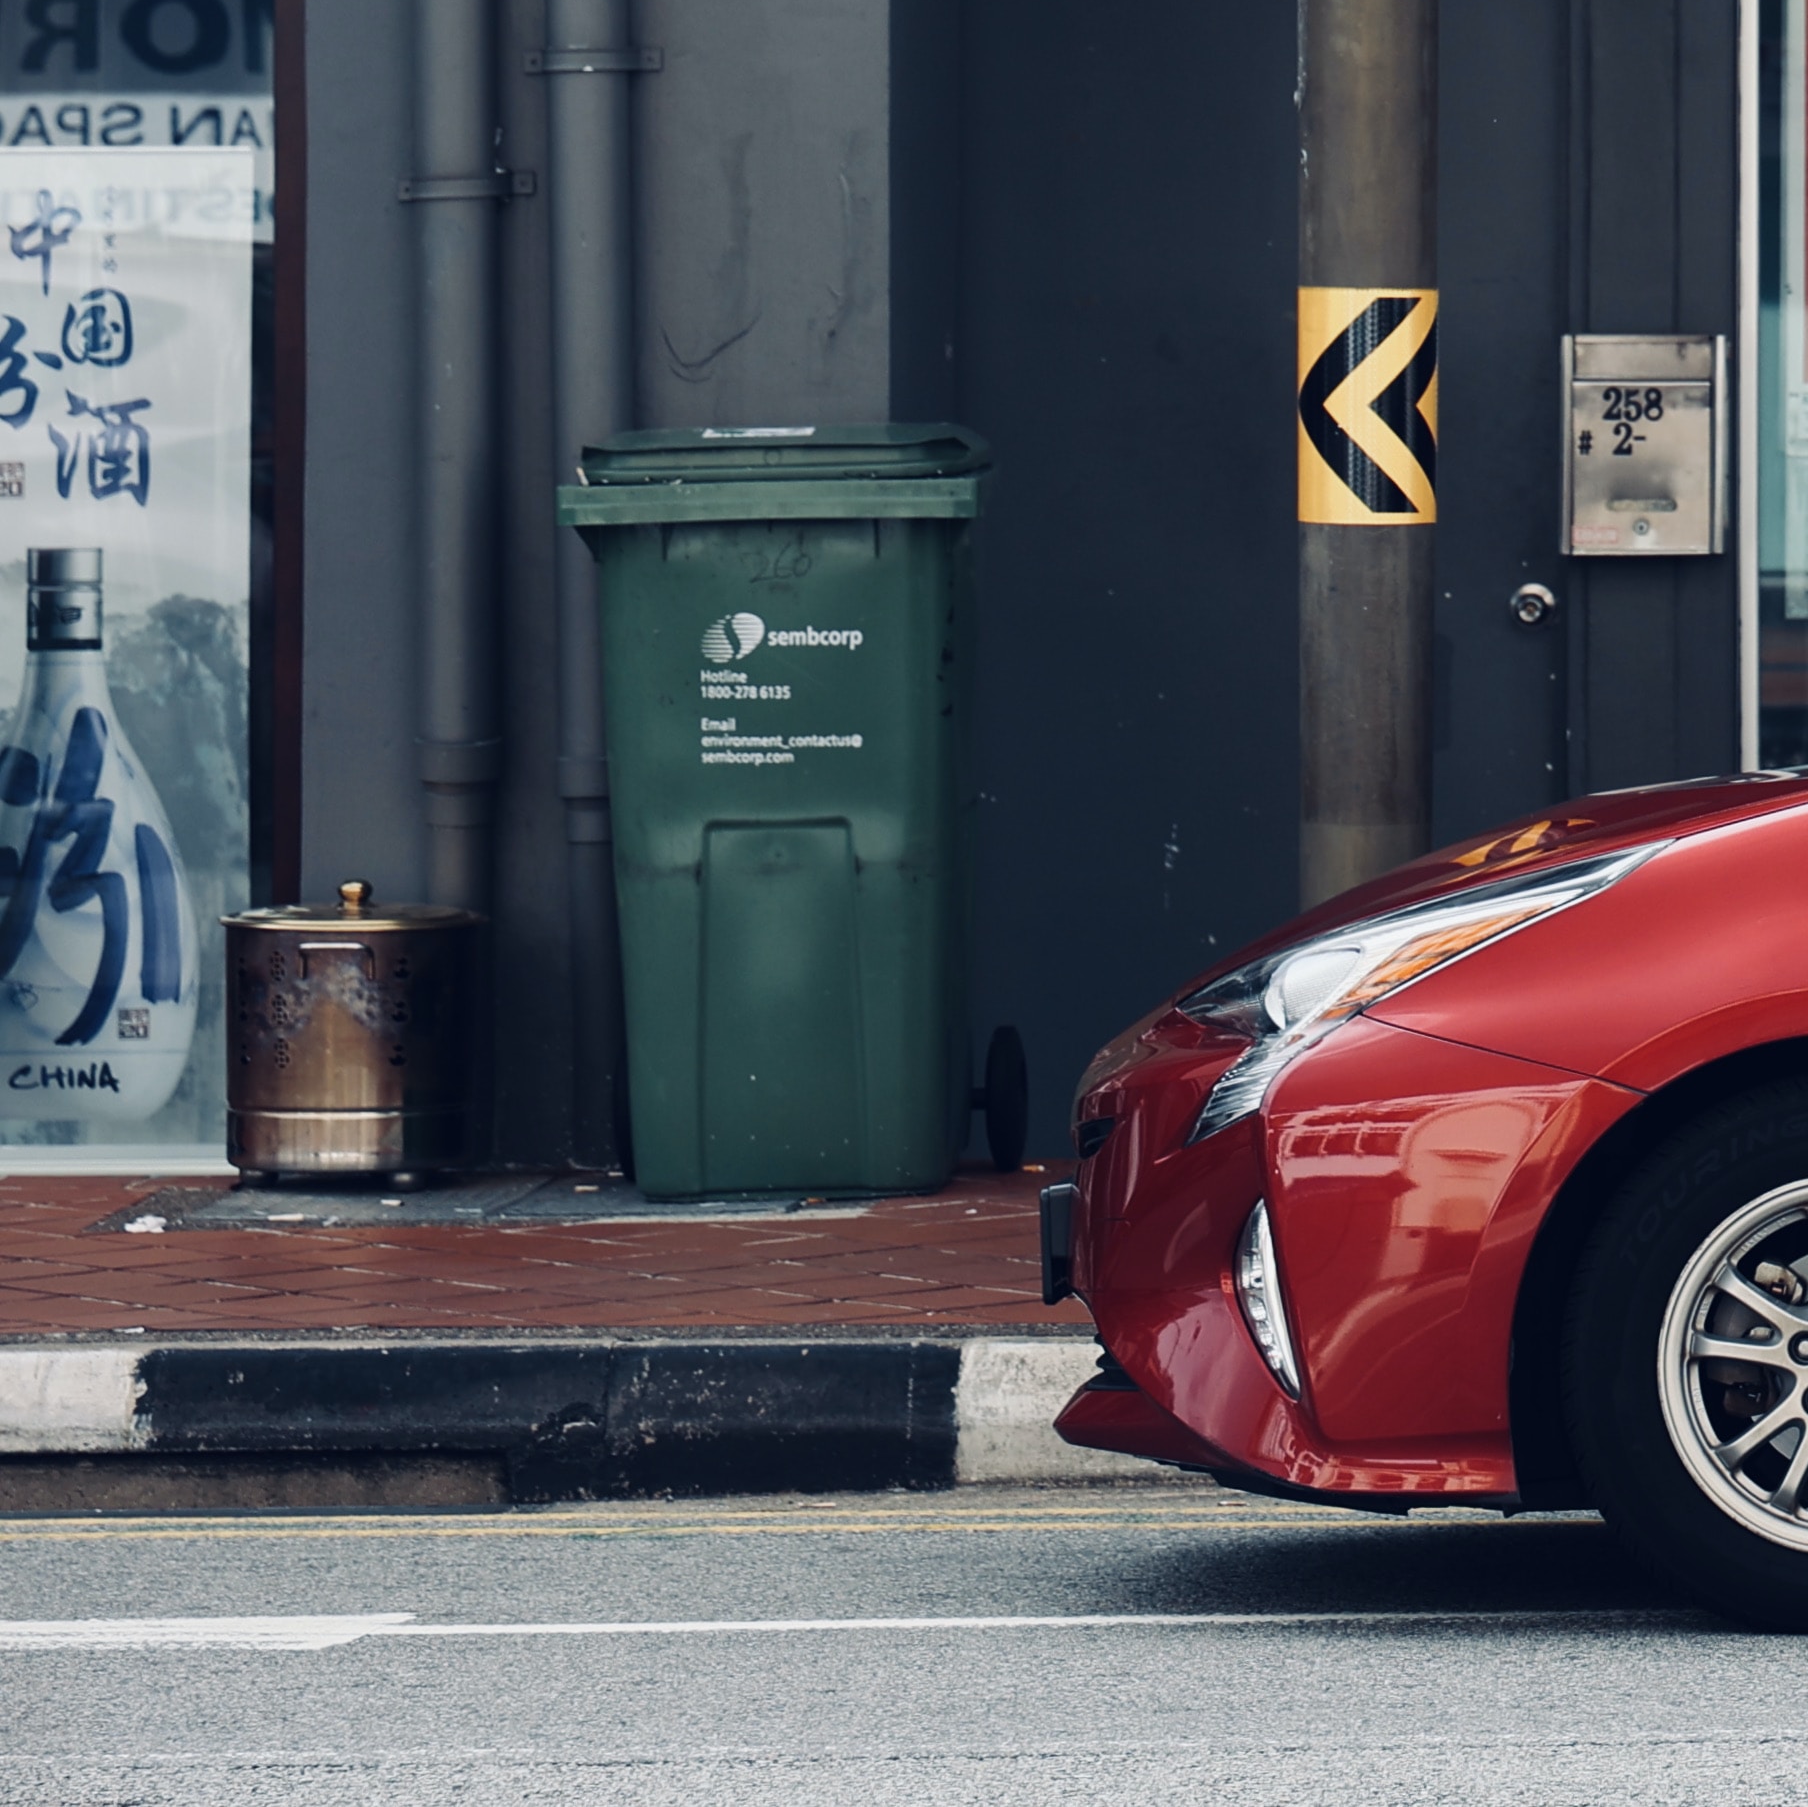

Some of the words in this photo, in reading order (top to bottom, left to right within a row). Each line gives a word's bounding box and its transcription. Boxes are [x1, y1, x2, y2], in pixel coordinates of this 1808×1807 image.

[1602, 386, 1664, 422] 258
[767, 625, 863, 651] sembcorp
[701, 670, 748, 684] Hotline
[701, 686, 757, 700] 1800-278
[759, 686, 791, 700] 6135
[701, 718, 736, 732] Email
[701, 734, 863, 750] environment_contactus@
[701, 750, 795, 767] sembcorp.com
[9, 1060, 120, 1093] CHINA
